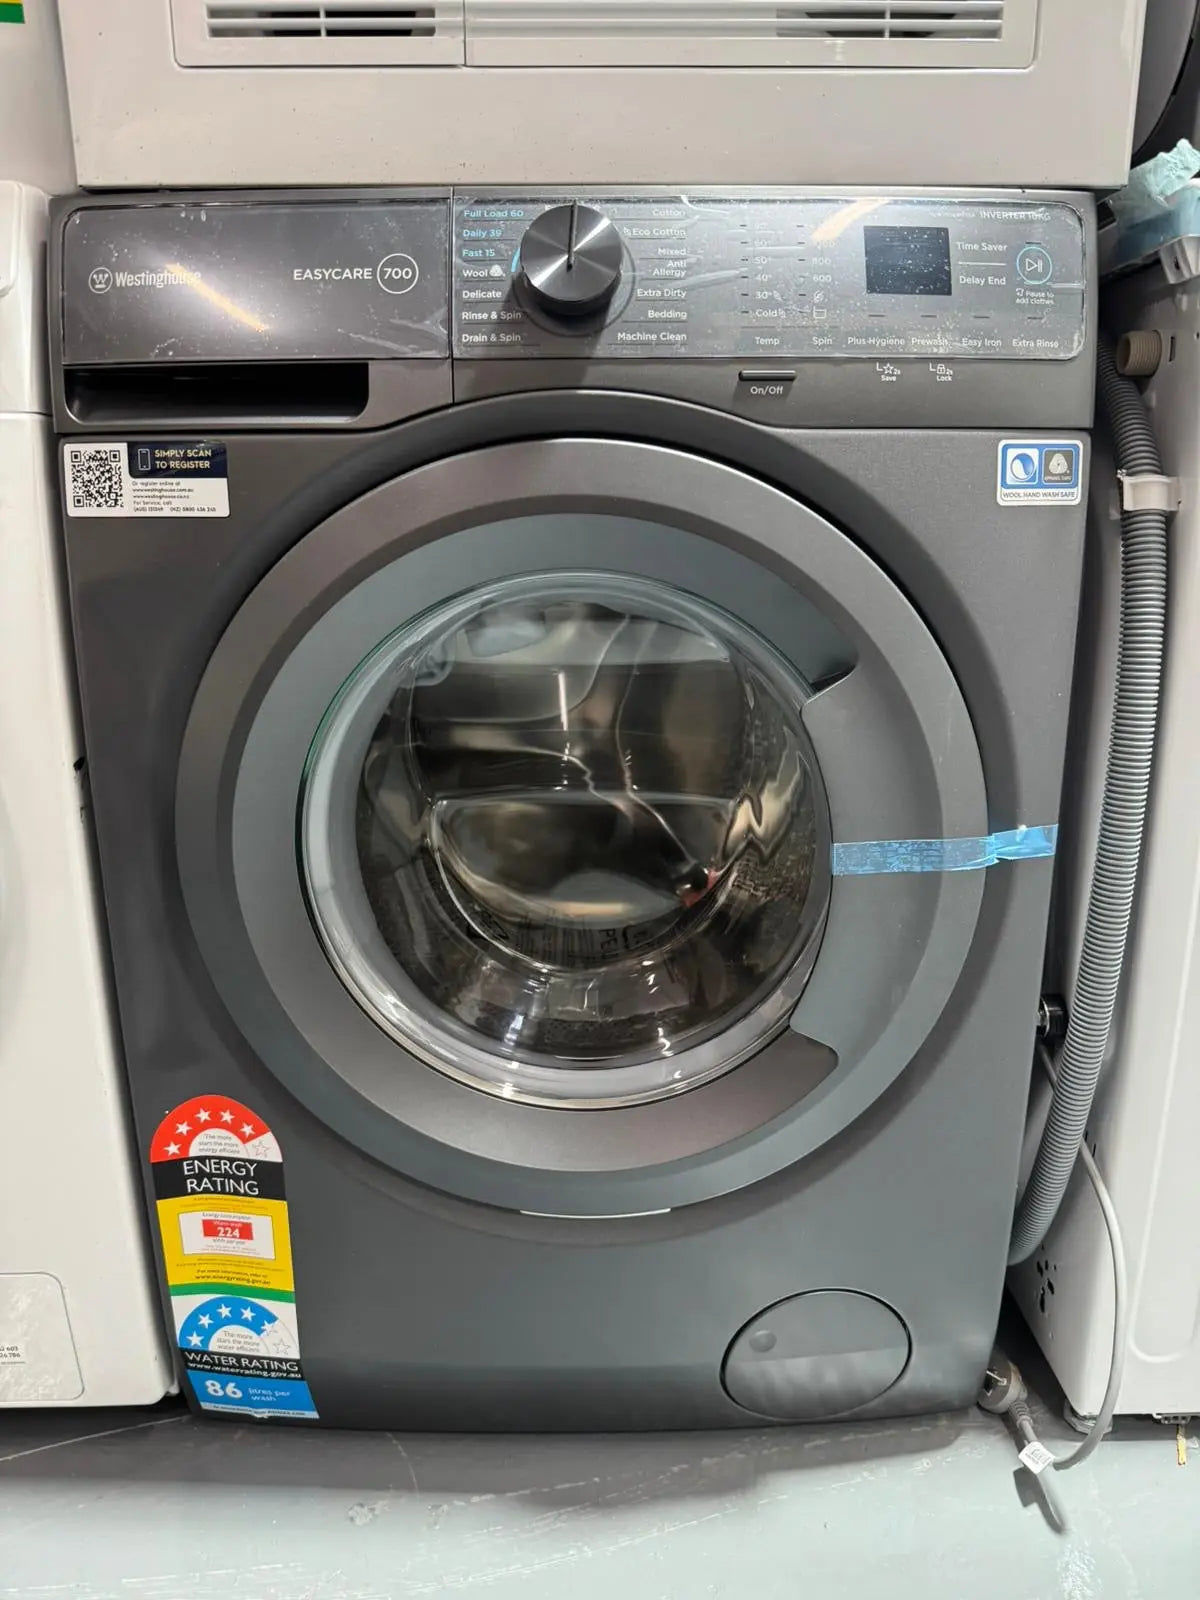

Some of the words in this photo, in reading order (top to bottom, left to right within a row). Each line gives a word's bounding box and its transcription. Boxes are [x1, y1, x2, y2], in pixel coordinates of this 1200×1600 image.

[463, 209, 482, 218] Full
[484, 209, 508, 218] Load
[510, 209, 524, 218] 60
[462, 229, 489, 239] Daily
[489, 229, 502, 238] 39
[632, 227, 651, 237] Eco
[652, 227, 687, 237] Cotton
[657, 247, 687, 256] Mixed
[956, 242, 978, 251] Time
[980, 242, 1008, 251] Saver
[462, 249, 484, 258] Fast
[485, 249, 496, 258] 15
[667, 260, 687, 268] Anti
[293, 268, 373, 281] EASYCARE
[383, 268, 412, 280] 700
[462, 268, 488, 278] Wool
[652, 268, 687, 279] Allergy
[115, 269, 202, 288] Westinghouse
[812, 274, 832, 283] 600
[959, 276, 986, 286] Delay
[988, 277, 1007, 286] End
[462, 289, 502, 299] Delicate
[637, 289, 662, 298] Extra
[663, 288, 687, 299] Dirty
[461, 311, 488, 321] Rinse
[490, 311, 498, 321] &
[500, 311, 522, 322] Spin
[648, 310, 688, 321] Bedding
[755, 309, 778, 318] Cold
[461, 333, 488, 343] Drain
[489, 333, 497, 342] &
[499, 333, 522, 343] Spin
[617, 332, 658, 342] Machine
[659, 332, 688, 342] Clean
[755, 337, 780, 346] Temp
[812, 336, 833, 346] Spin
[911, 337, 949, 347] Prewash
[962, 338, 983, 348] Easy
[984, 338, 1002, 347] Iron
[1012, 338, 1035, 348] Extra
[1036, 339, 1059, 348] Rinse
[750, 385, 784, 396] On/Off
[154, 450, 185, 458] SIMPLY
[186, 449, 212, 458] SCAN
[156, 460, 168, 469] TO
[169, 460, 210, 469] REGISTER
[1003, 491, 1022, 499] WOOL
[1023, 491, 1041, 499] HAND
[182, 1159, 258, 1177] ENERGY
[186, 1178, 259, 1195] RATING
[217, 1226, 240, 1239] 224
[185, 1352, 239, 1367] WATER
[241, 1358, 298, 1371] RATING
[188, 1362, 302, 1378] www.waterrating.gov.au
[205, 1380, 243, 1399] 86
[248, 1387, 273, 1396] litres
[274, 1390, 291, 1398] per
